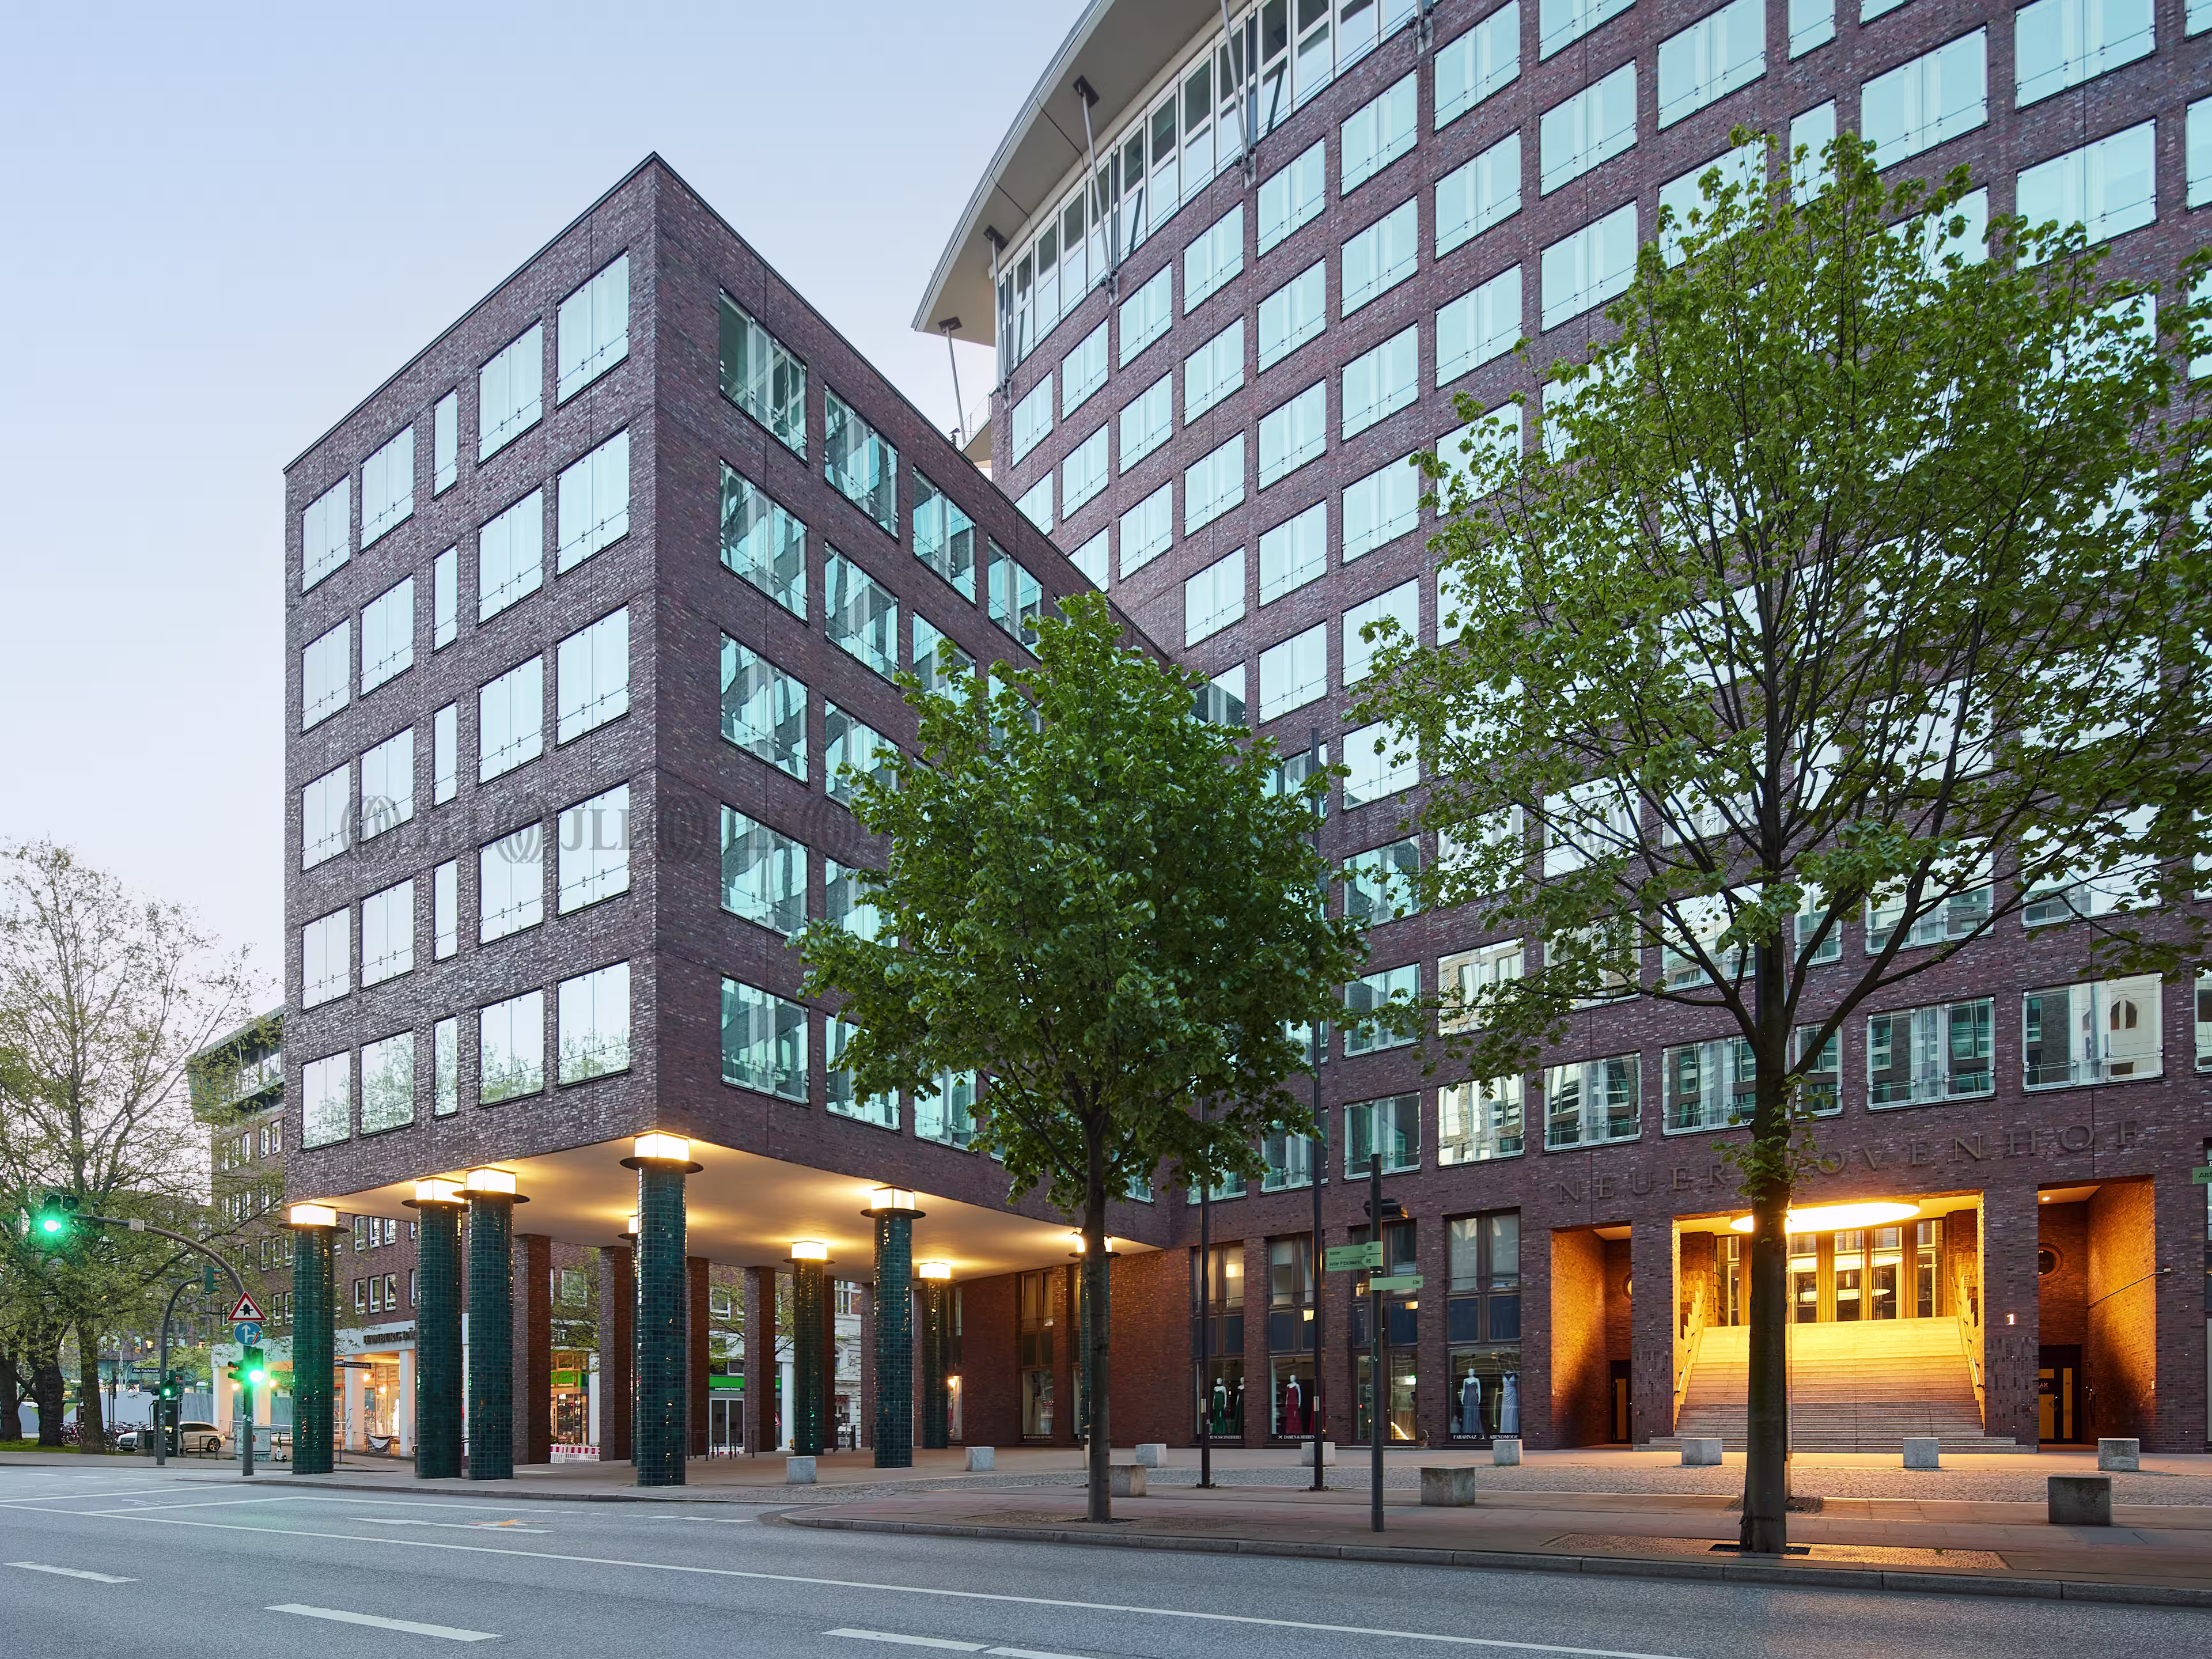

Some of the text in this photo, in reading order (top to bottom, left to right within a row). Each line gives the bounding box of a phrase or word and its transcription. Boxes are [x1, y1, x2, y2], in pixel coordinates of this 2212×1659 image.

[1558, 1119, 2139, 1203] NEUER OVENHOF
[2006, 1313, 2016, 1325] 1
[363, 1331, 402, 1344] HAMBURG
